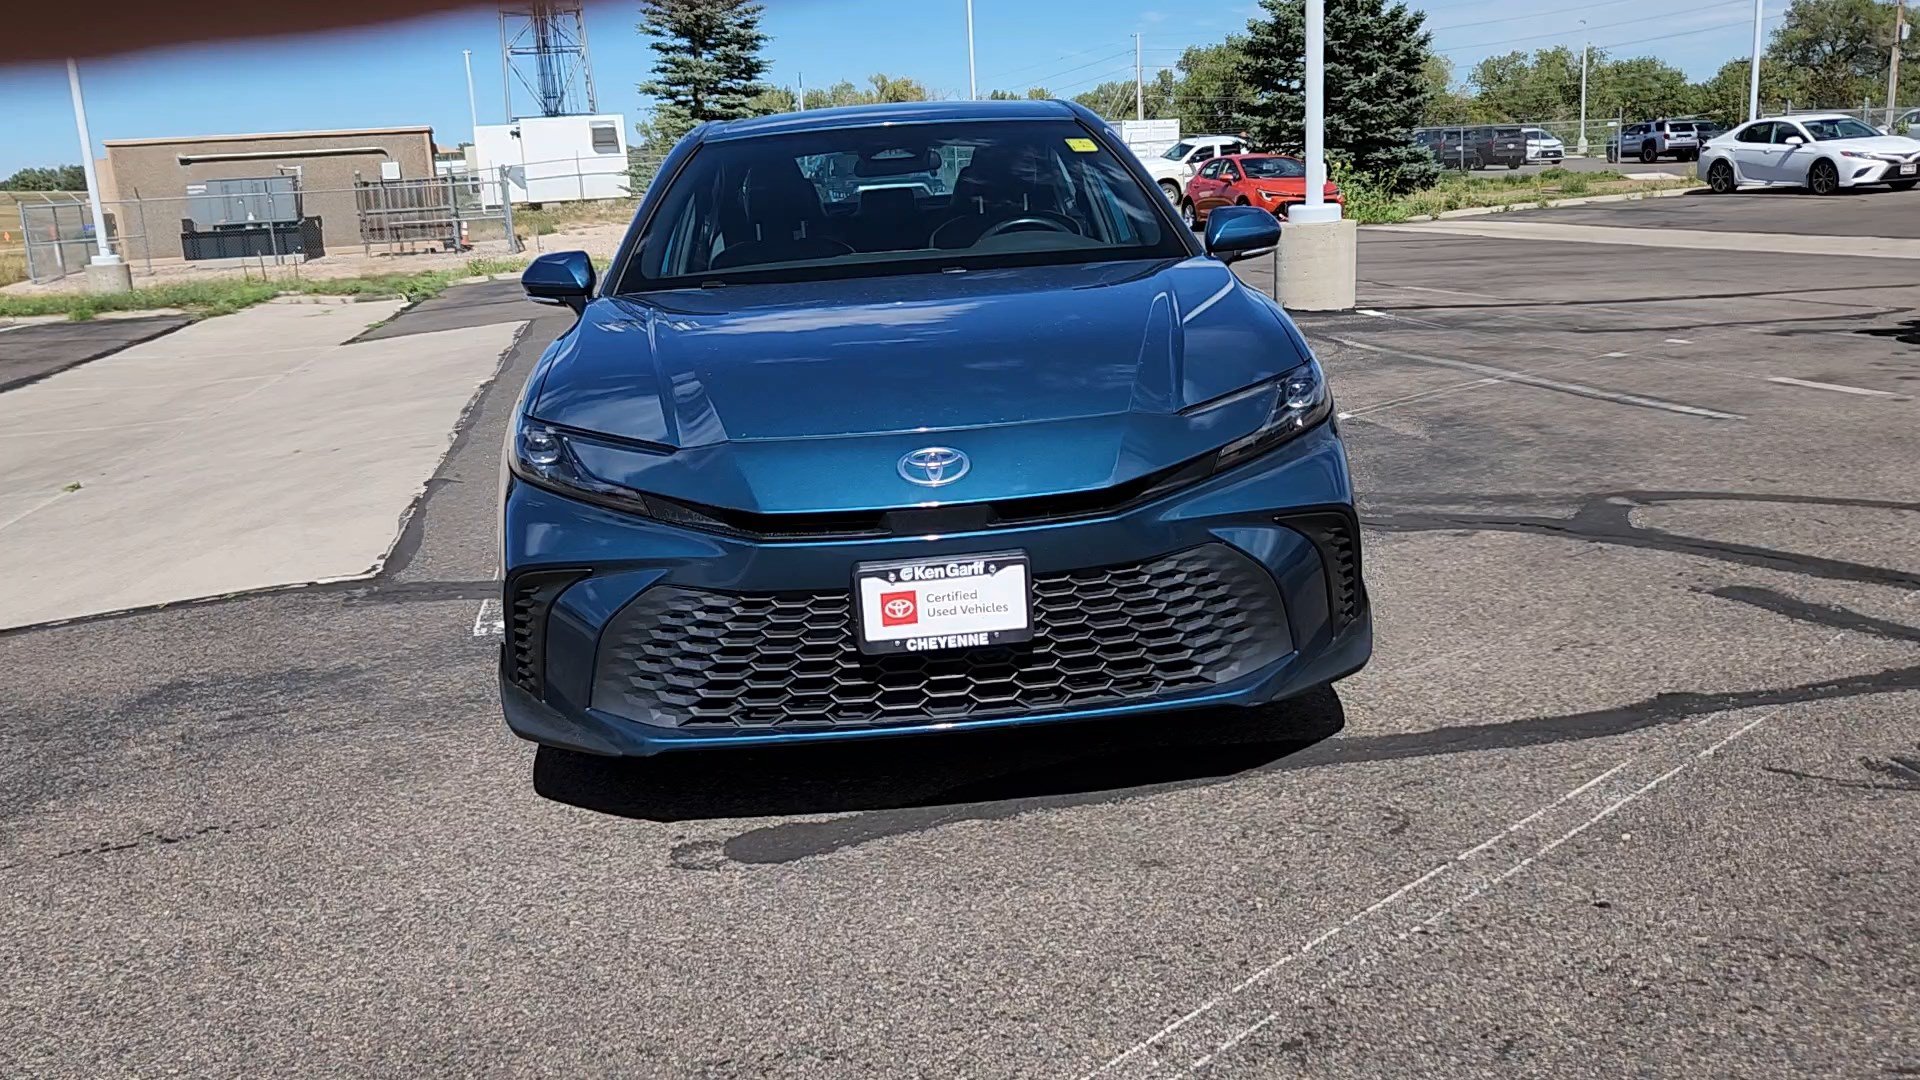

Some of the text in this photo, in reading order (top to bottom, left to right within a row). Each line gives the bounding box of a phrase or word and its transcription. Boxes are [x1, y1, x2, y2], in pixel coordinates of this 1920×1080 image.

[914, 566, 945, 580] Ken
[946, 561, 984, 577] Garff
[926, 590, 978, 603] Certified
[927, 602, 1009, 617] Used Vehicles
[906, 632, 989, 651] CHEYENNE
